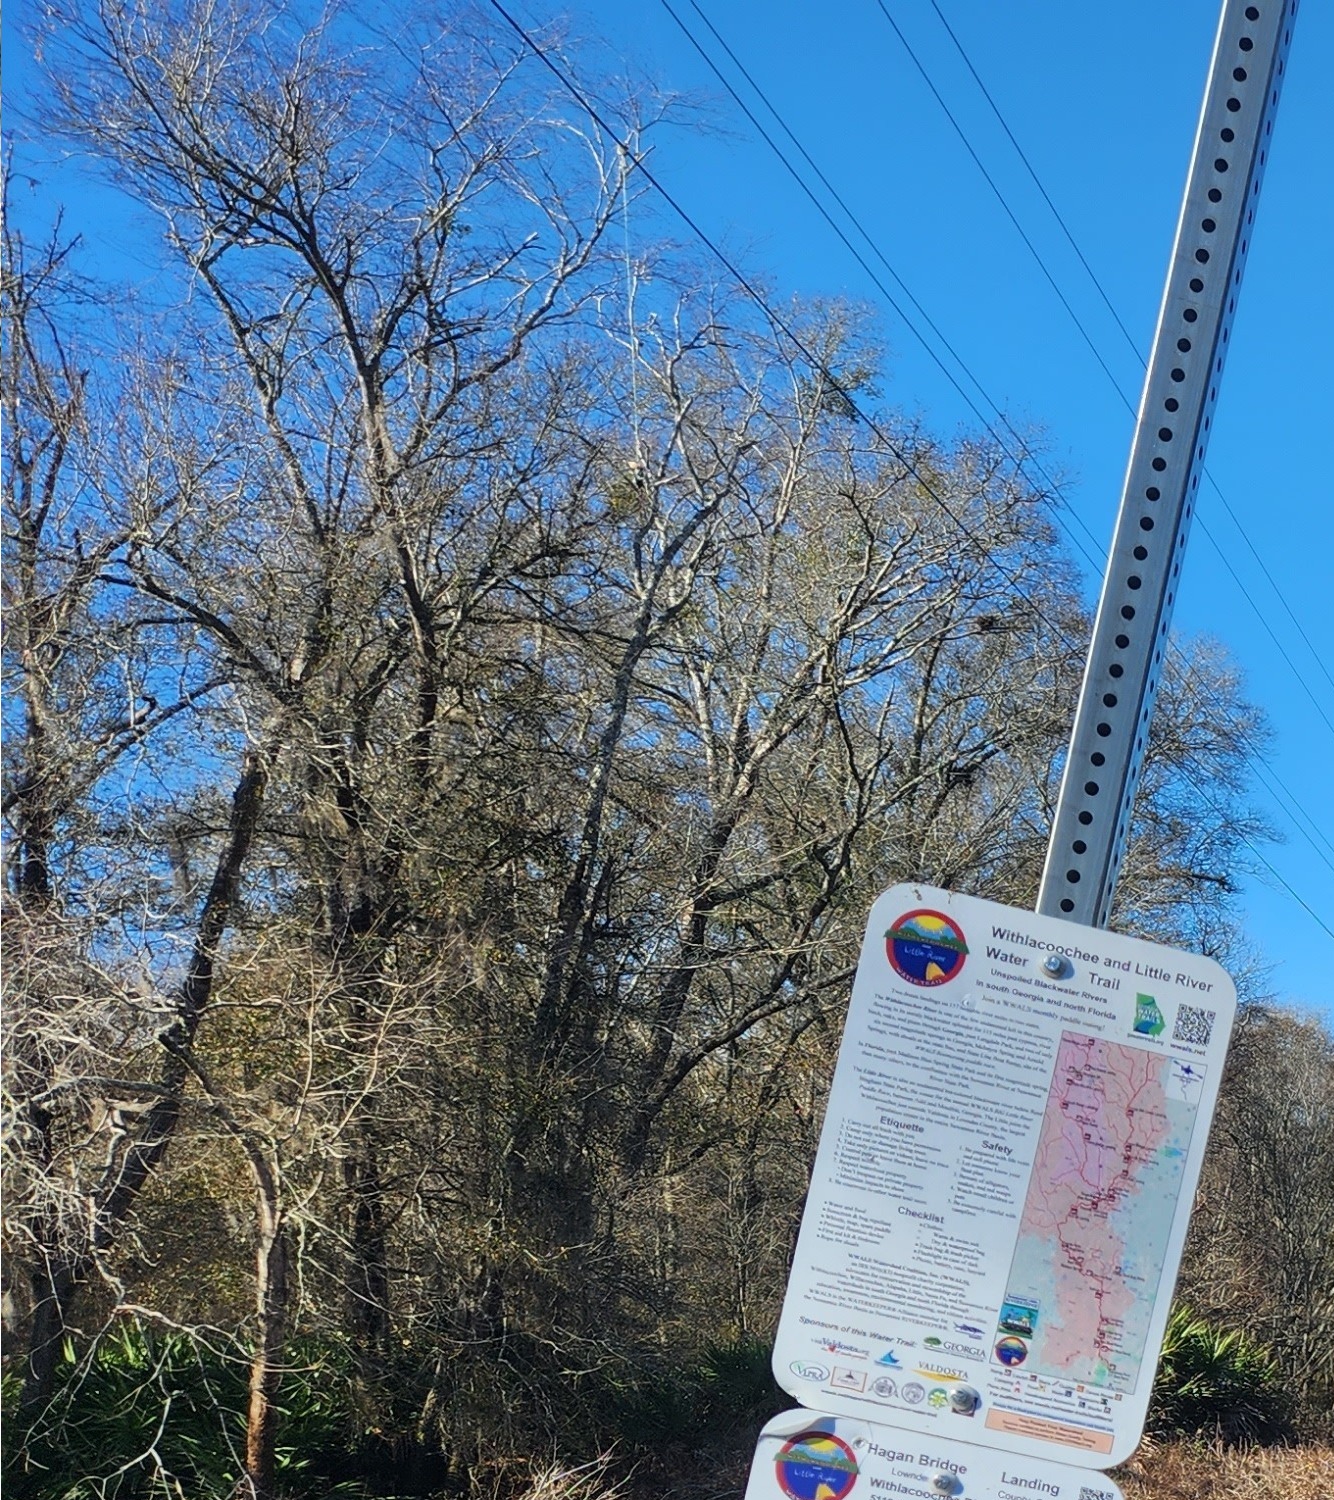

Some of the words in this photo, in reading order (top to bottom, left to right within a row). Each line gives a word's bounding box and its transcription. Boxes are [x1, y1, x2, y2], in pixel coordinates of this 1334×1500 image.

[985, 945, 1029, 967] Water
[1088, 971, 1120, 991] Trail
[991, 925, 1099, 964] Withlacoochee
[1102, 957, 1131, 972] and
[1134, 962, 1171, 982] Little
[1174, 972, 1213, 993] River
[990, 967, 1033, 985] Unspoiled
[1033, 978, 1080, 996] Blackwater
[1080, 990, 1107, 1004] Rivers
[985, 982, 1010, 993] south
[1011, 988, 1044, 1003] Georgia
[1045, 997, 1062, 1007] and
[1062, 1002, 1086, 1012] north
[1087, 1006, 1116, 1020] Florida
[879, 1115, 924, 1133] Etiquette
[981, 1139, 1013, 1156] Safety
[897, 1205, 944, 1224] Checklist
[798, 1315, 839, 1331] Sponsors
[850, 1328, 867, 1337] this
[868, 1331, 894, 1342] Water
[942, 1340, 986, 1359] GEORGIA
[918, 1360, 969, 1379] VALDOSTA
[867, 1442, 914, 1463] Hagan
[918, 1453, 967, 1475] Bridge
[1000, 1471, 1060, 1497] Landing
[890, 1466, 929, 1482] Lownde
